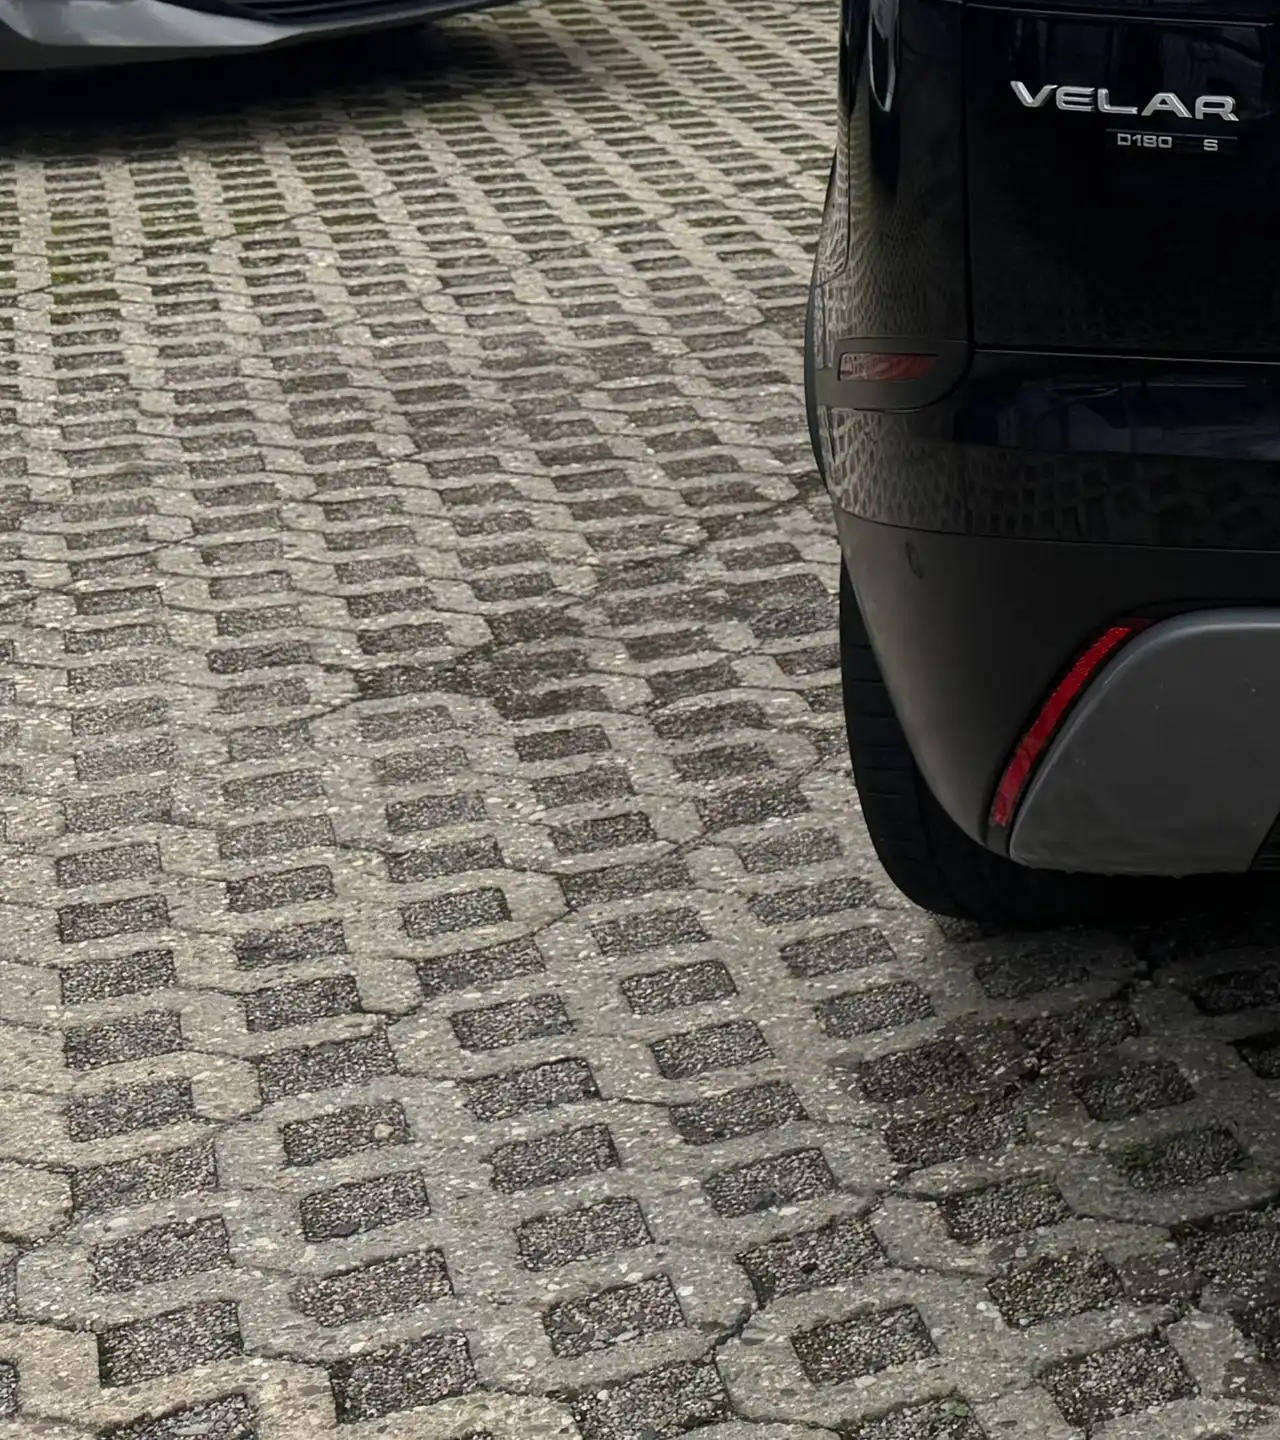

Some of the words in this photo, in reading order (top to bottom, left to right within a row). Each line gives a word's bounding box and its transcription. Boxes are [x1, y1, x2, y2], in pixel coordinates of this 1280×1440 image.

[1010, 80, 1239, 122] VELAR
[1117, 133, 1172, 149] D180
[1203, 140, 1218, 151] S
